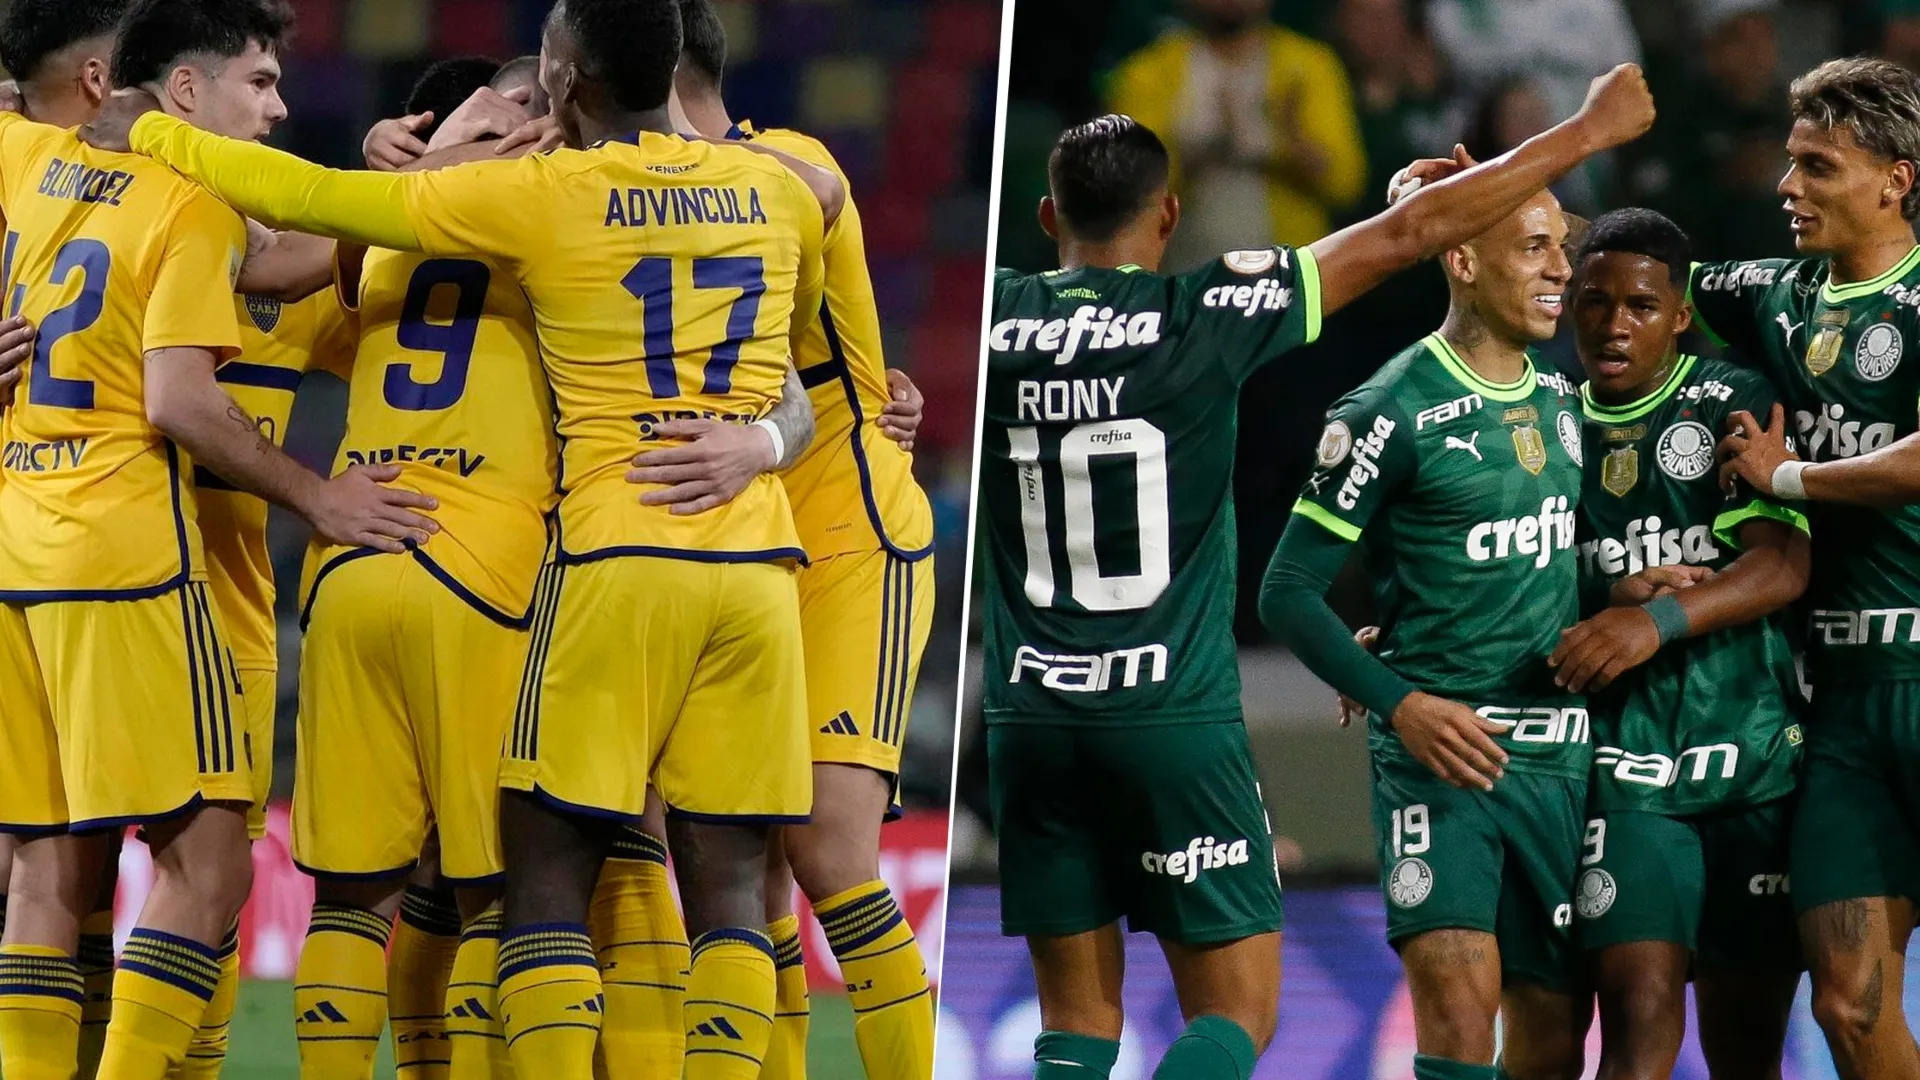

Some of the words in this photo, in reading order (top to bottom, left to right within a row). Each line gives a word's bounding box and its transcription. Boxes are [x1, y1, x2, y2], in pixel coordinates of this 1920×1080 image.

[37, 158, 135, 206] BLONDEL
[604, 187, 767, 227] ADVINCULA
[249, 303, 278, 315] CABJ
[619, 256, 767, 399] 17
[383, 258, 491, 411] 9
[989, 305, 1162, 366] crefisa
[1858, 346, 1900, 377] PALMEIRAS
[1018, 376, 1126, 421] RONY
[1676, 379, 1734, 405] efisa
[1089, 429, 1133, 446] crefisa
[1785, 402, 1896, 462] efisa
[1336, 414, 1397, 510] crefisa
[1660, 444, 1713, 476] PALMEIRAS
[1007, 418, 1170, 611] 10
[1466, 495, 1576, 570] crefis
[1575, 515, 1720, 578] refisa
[1392, 804, 1431, 857] 19
[1582, 818, 1606, 866] 9
[1141, 836, 1250, 884] crefisa
